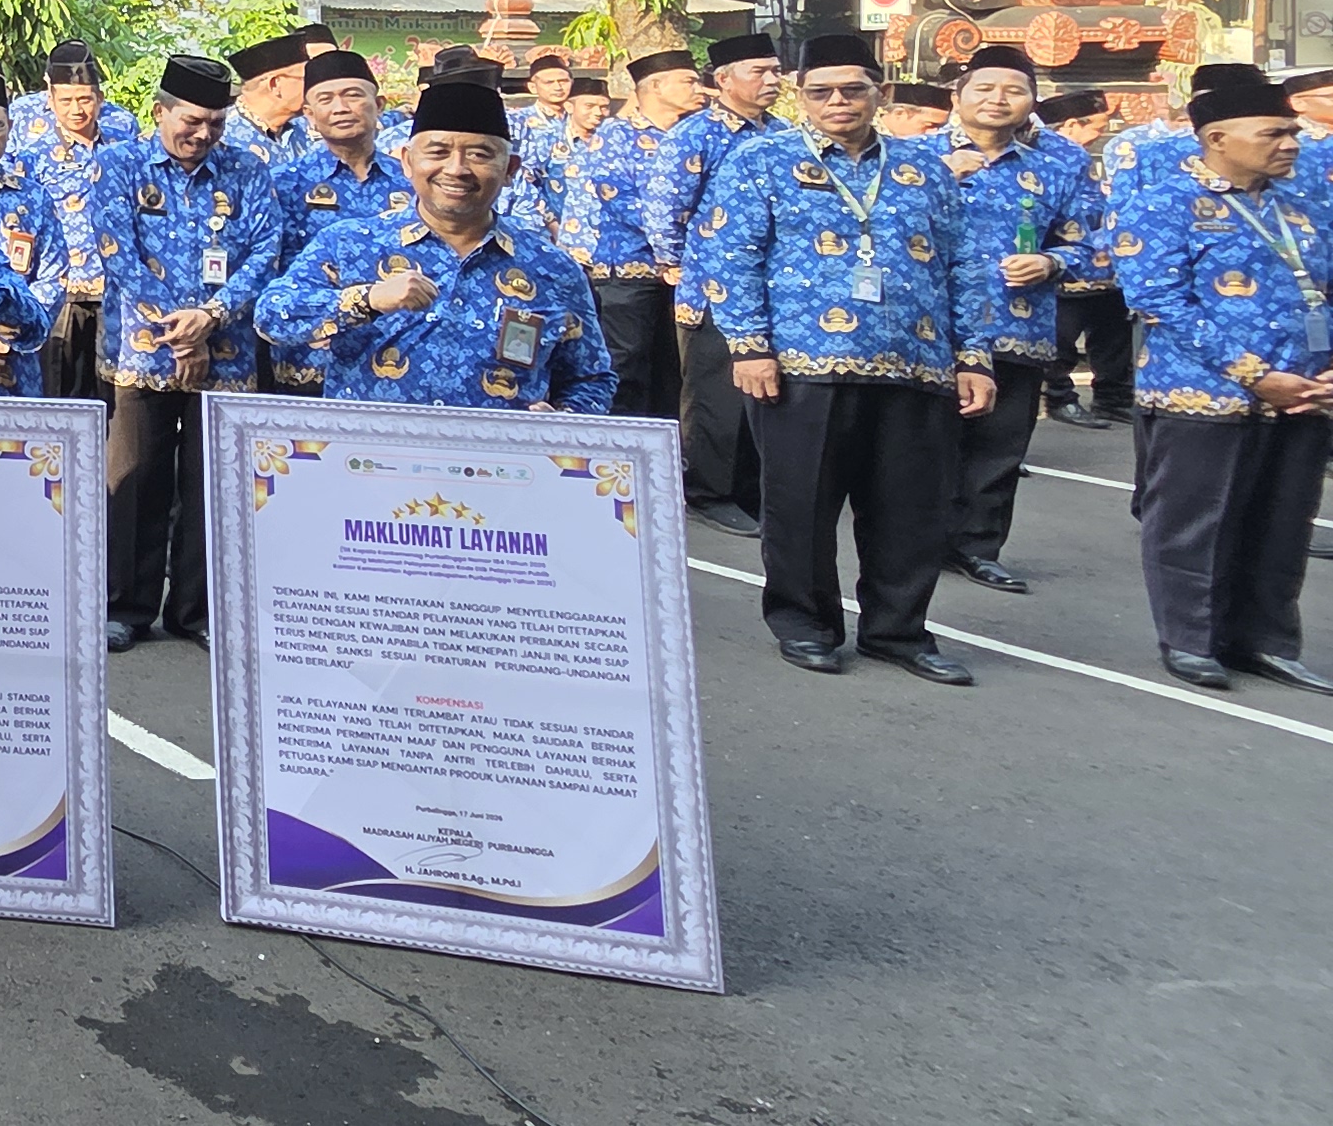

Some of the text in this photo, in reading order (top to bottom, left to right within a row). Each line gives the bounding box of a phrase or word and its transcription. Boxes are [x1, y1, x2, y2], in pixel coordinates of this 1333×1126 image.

[344, 518, 548, 557] MAKLUMAT LAYANAN
[272, 599, 332, 613] PELAYANAN
[334, 604, 370, 617] SESUAI
[372, 608, 420, 621] STANDAR
[422, 612, 485, 627] PELAYANAN
[486, 618, 518, 630] YANG
[519, 621, 555, 634] TELAH
[343, 592, 371, 603] KAMI
[374, 594, 445, 610] MENYATAKAN
[449, 601, 502, 614] SANGGUP
[506, 606, 627, 626] MENYELENGGARAKAN
[273, 613, 629, 654] SESUAI DENGAN KEWAJIBAN DAN MELAKUKAN PERBAIKAN SECARA
[415, 695, 484, 710] KOMPENSASI
[12, 746, 51, 757] ALAMAT
[363, 827, 414, 841] MADRASAH
[416, 833, 449, 845] ALIYAH
[487, 841, 554, 857] PURBALINGGA
[437, 827, 474, 839] KEPALA
[416, 867, 461, 880] JAHRONI
